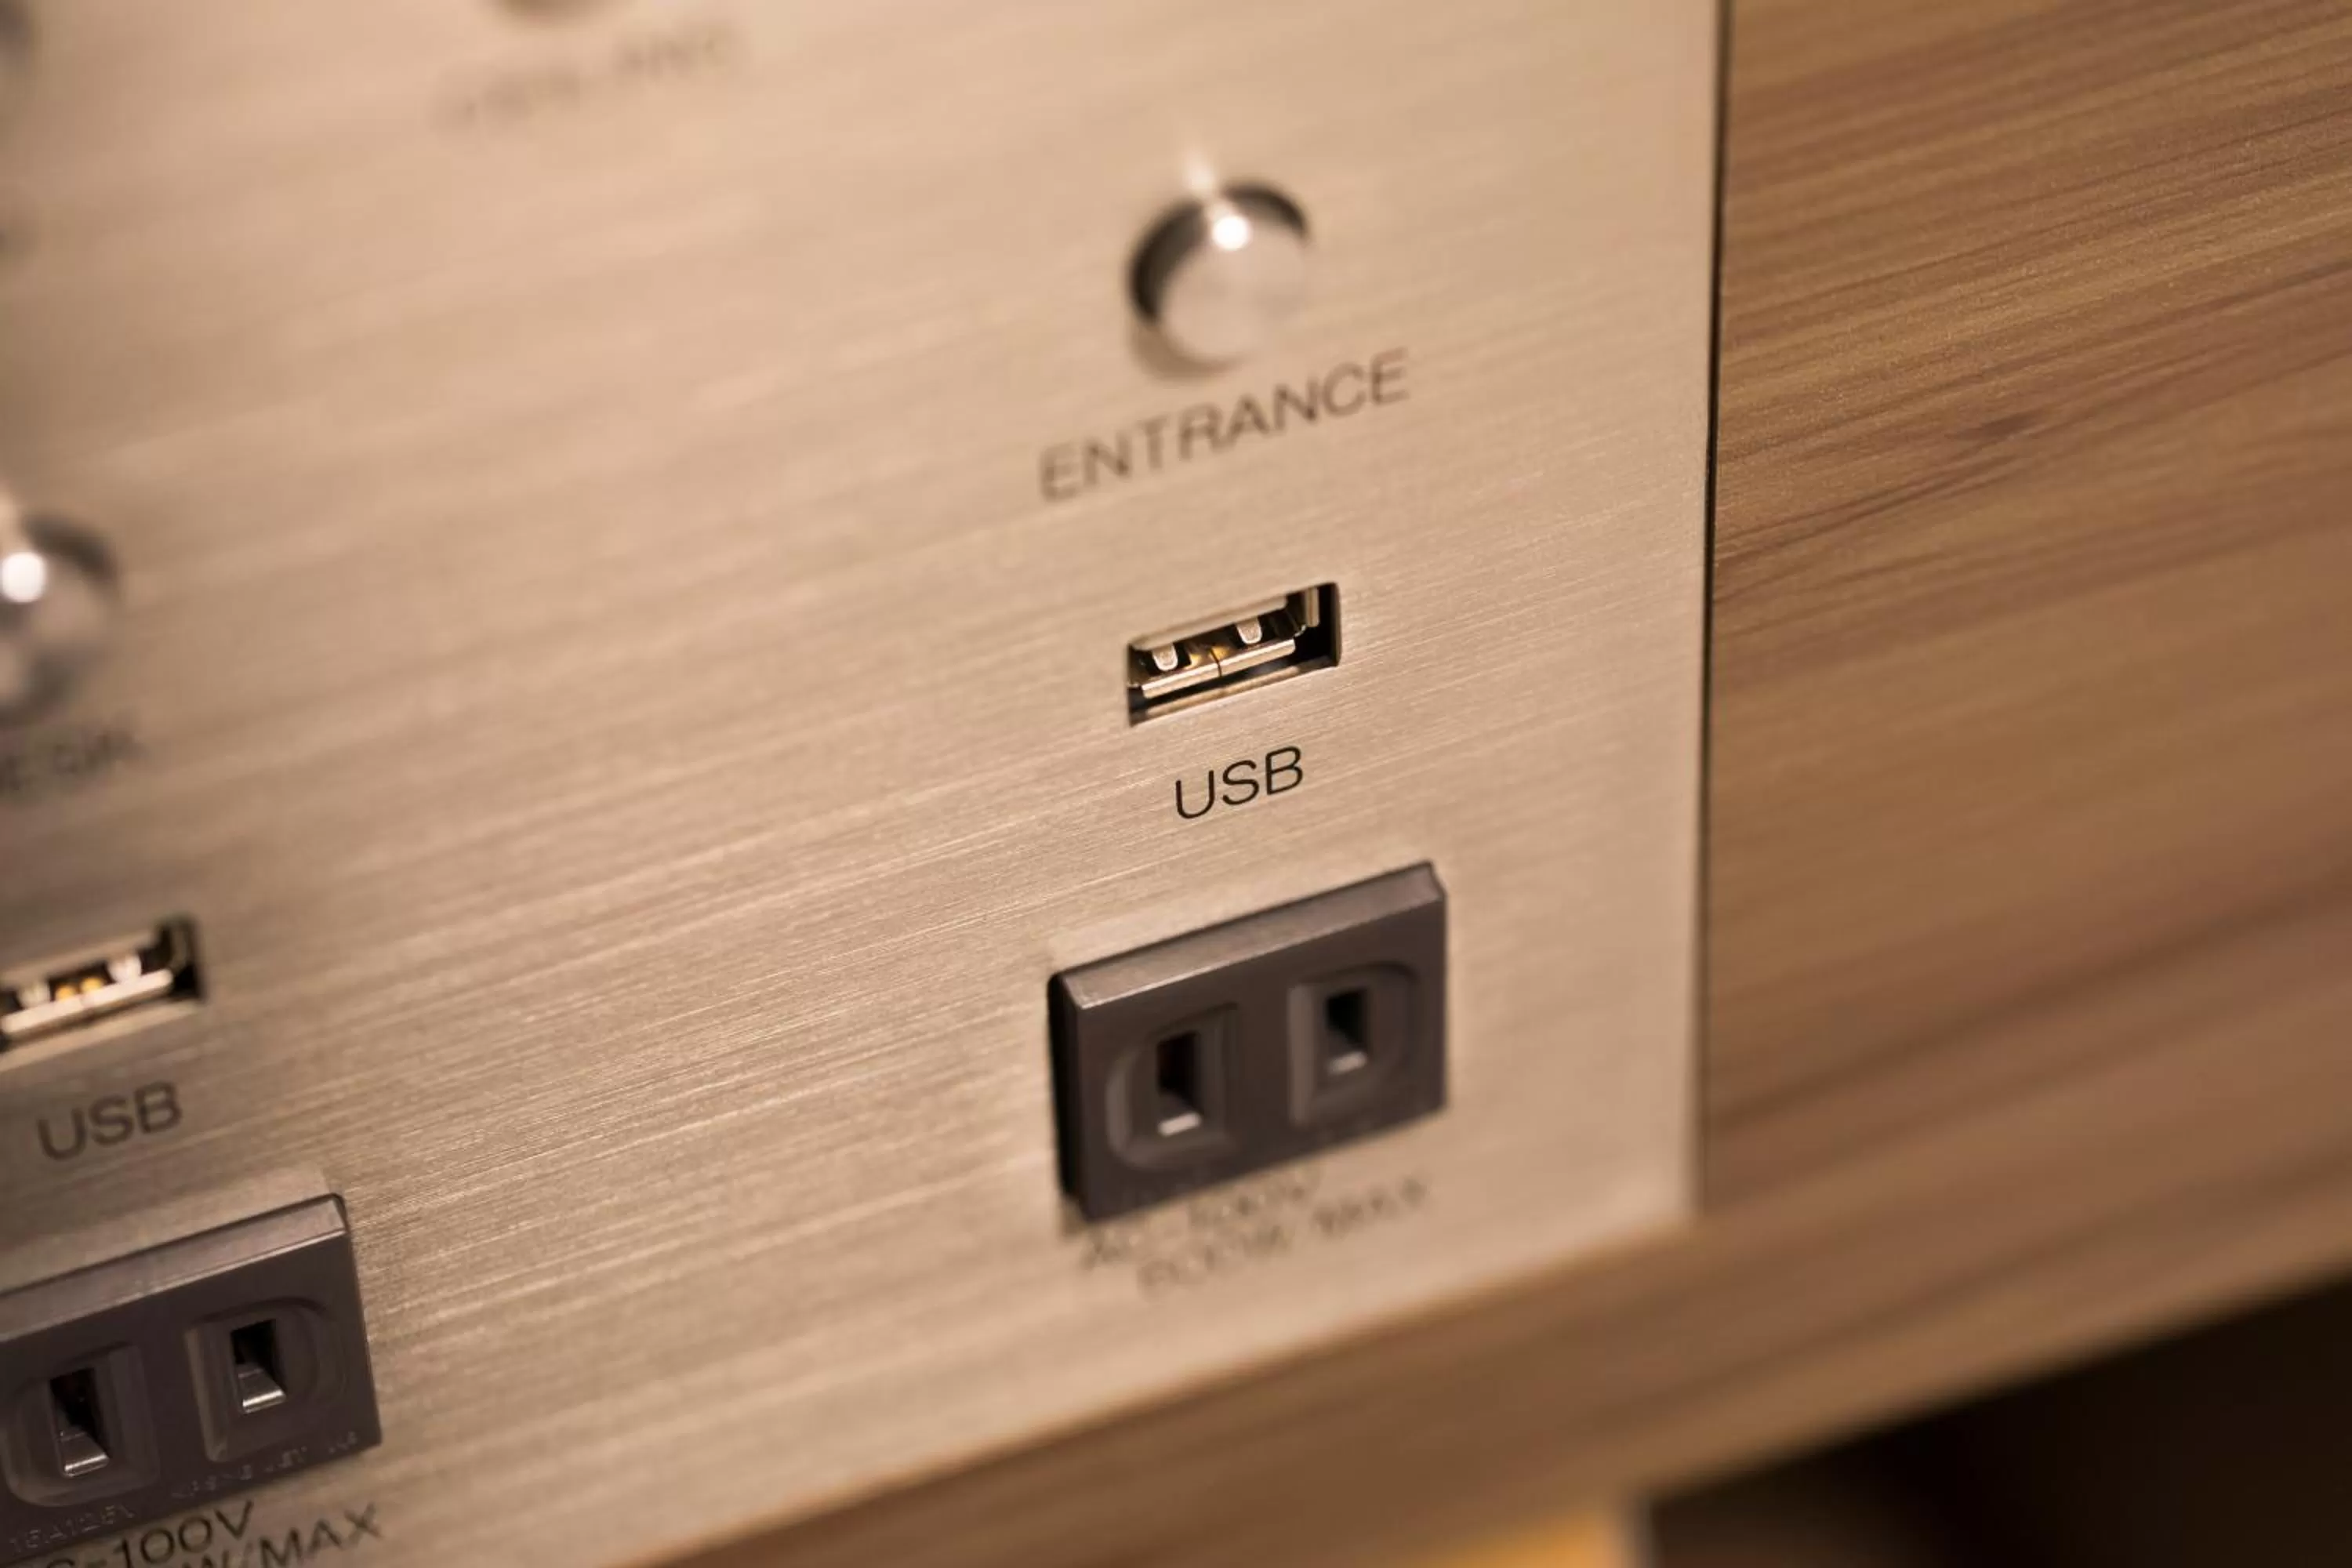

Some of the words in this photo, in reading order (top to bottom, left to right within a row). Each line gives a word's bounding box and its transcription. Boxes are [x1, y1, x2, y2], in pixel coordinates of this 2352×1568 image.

[1038, 347, 1410, 503] ENTRANCE
[1175, 746, 1303, 819] USB
[37, 1081, 183, 1161] USB
[45, 1499, 254, 1568] -100V
